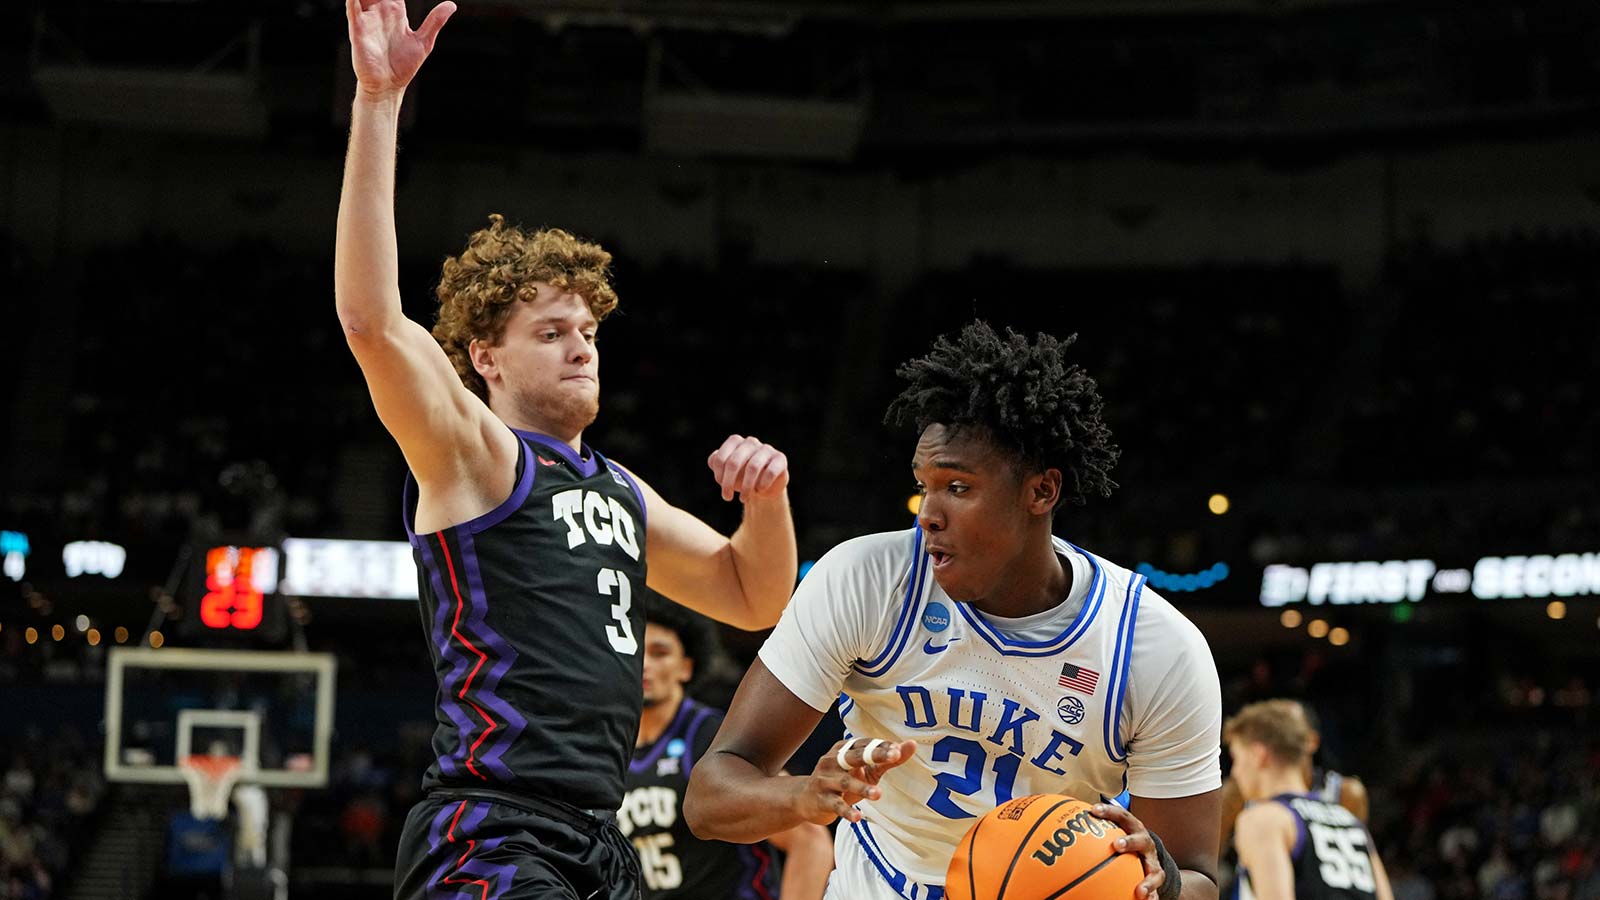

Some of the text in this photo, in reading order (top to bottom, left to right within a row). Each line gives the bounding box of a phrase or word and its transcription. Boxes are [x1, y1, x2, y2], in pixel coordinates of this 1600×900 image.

[552, 489, 641, 562] TCU
[597, 567, 639, 656] 3
[924, 615, 948, 626] NCAA
[896, 685, 1085, 776] DUKE
[1060, 703, 1084, 717] ACC
[926, 735, 1021, 821] 21
[633, 832, 683, 890] 15
[1031, 809, 1119, 867] ilson
[1308, 821, 1377, 894] 55
